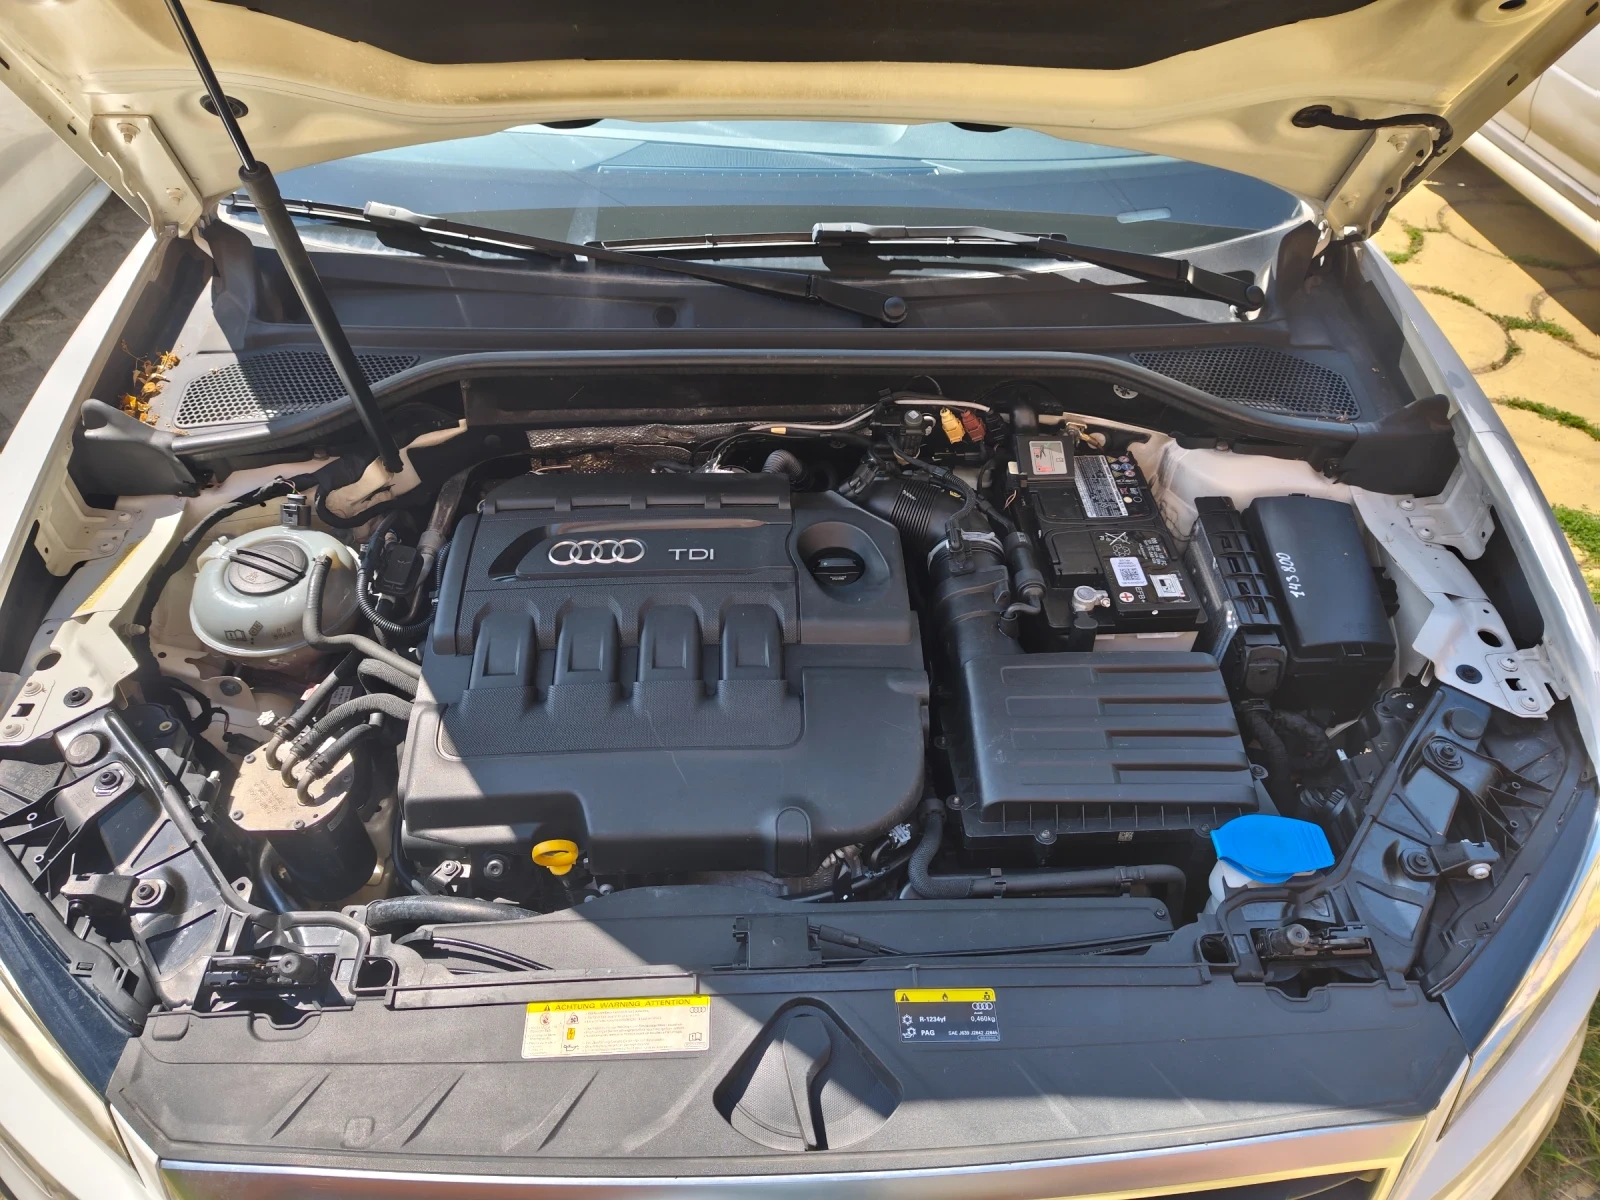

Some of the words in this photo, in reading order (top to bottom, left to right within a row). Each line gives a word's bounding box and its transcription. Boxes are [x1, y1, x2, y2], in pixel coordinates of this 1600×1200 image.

[668, 548, 714, 561] TDI
[555, 1002, 596, 1011] ACHTUNG
[600, 1000, 641, 1009] WARNING
[645, 998, 691, 1007] ATTENTION
